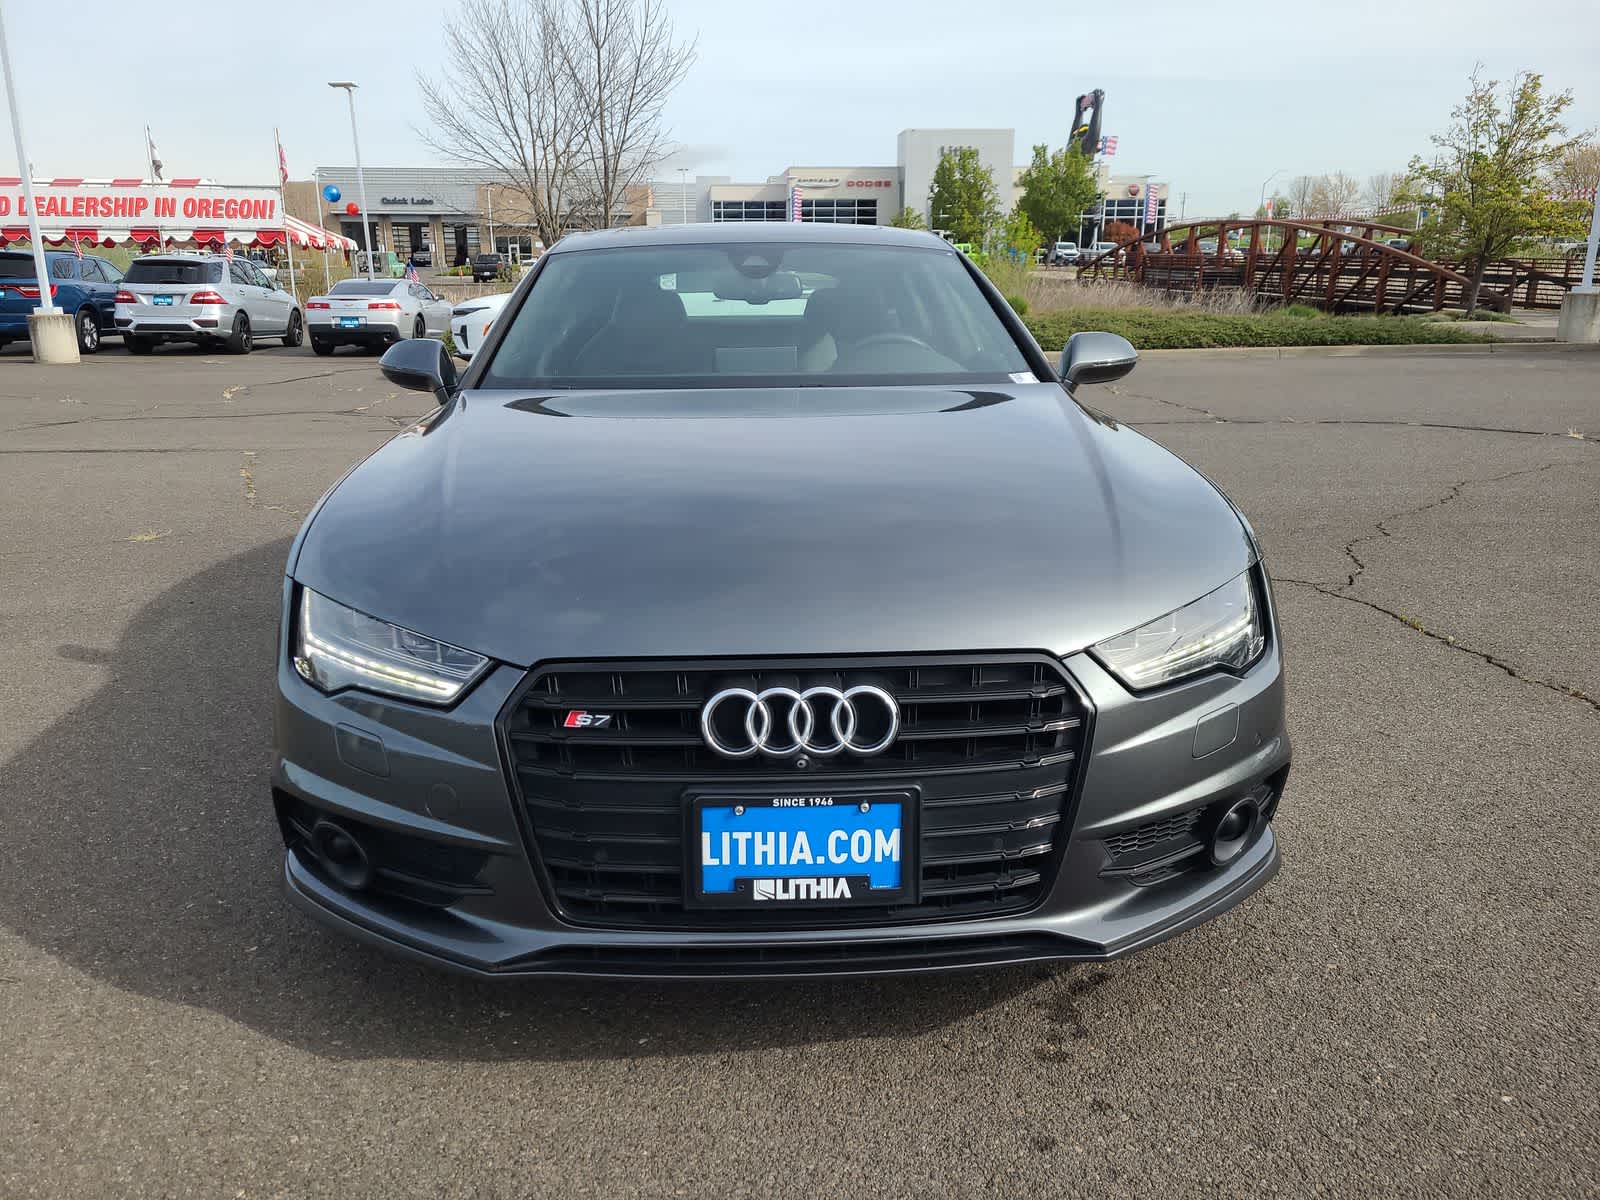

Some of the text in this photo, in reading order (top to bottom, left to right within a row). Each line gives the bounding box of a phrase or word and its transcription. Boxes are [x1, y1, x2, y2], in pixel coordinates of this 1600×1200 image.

[847, 180, 893, 188] DODGE
[154, 197, 176, 217] IN
[183, 198, 275, 219] OREGON!
[574, 713, 611, 726] S7
[772, 797, 834, 807] SINCE 1946
[701, 828, 901, 866] LITHIA.COM
[776, 877, 852, 900] LITHIA
